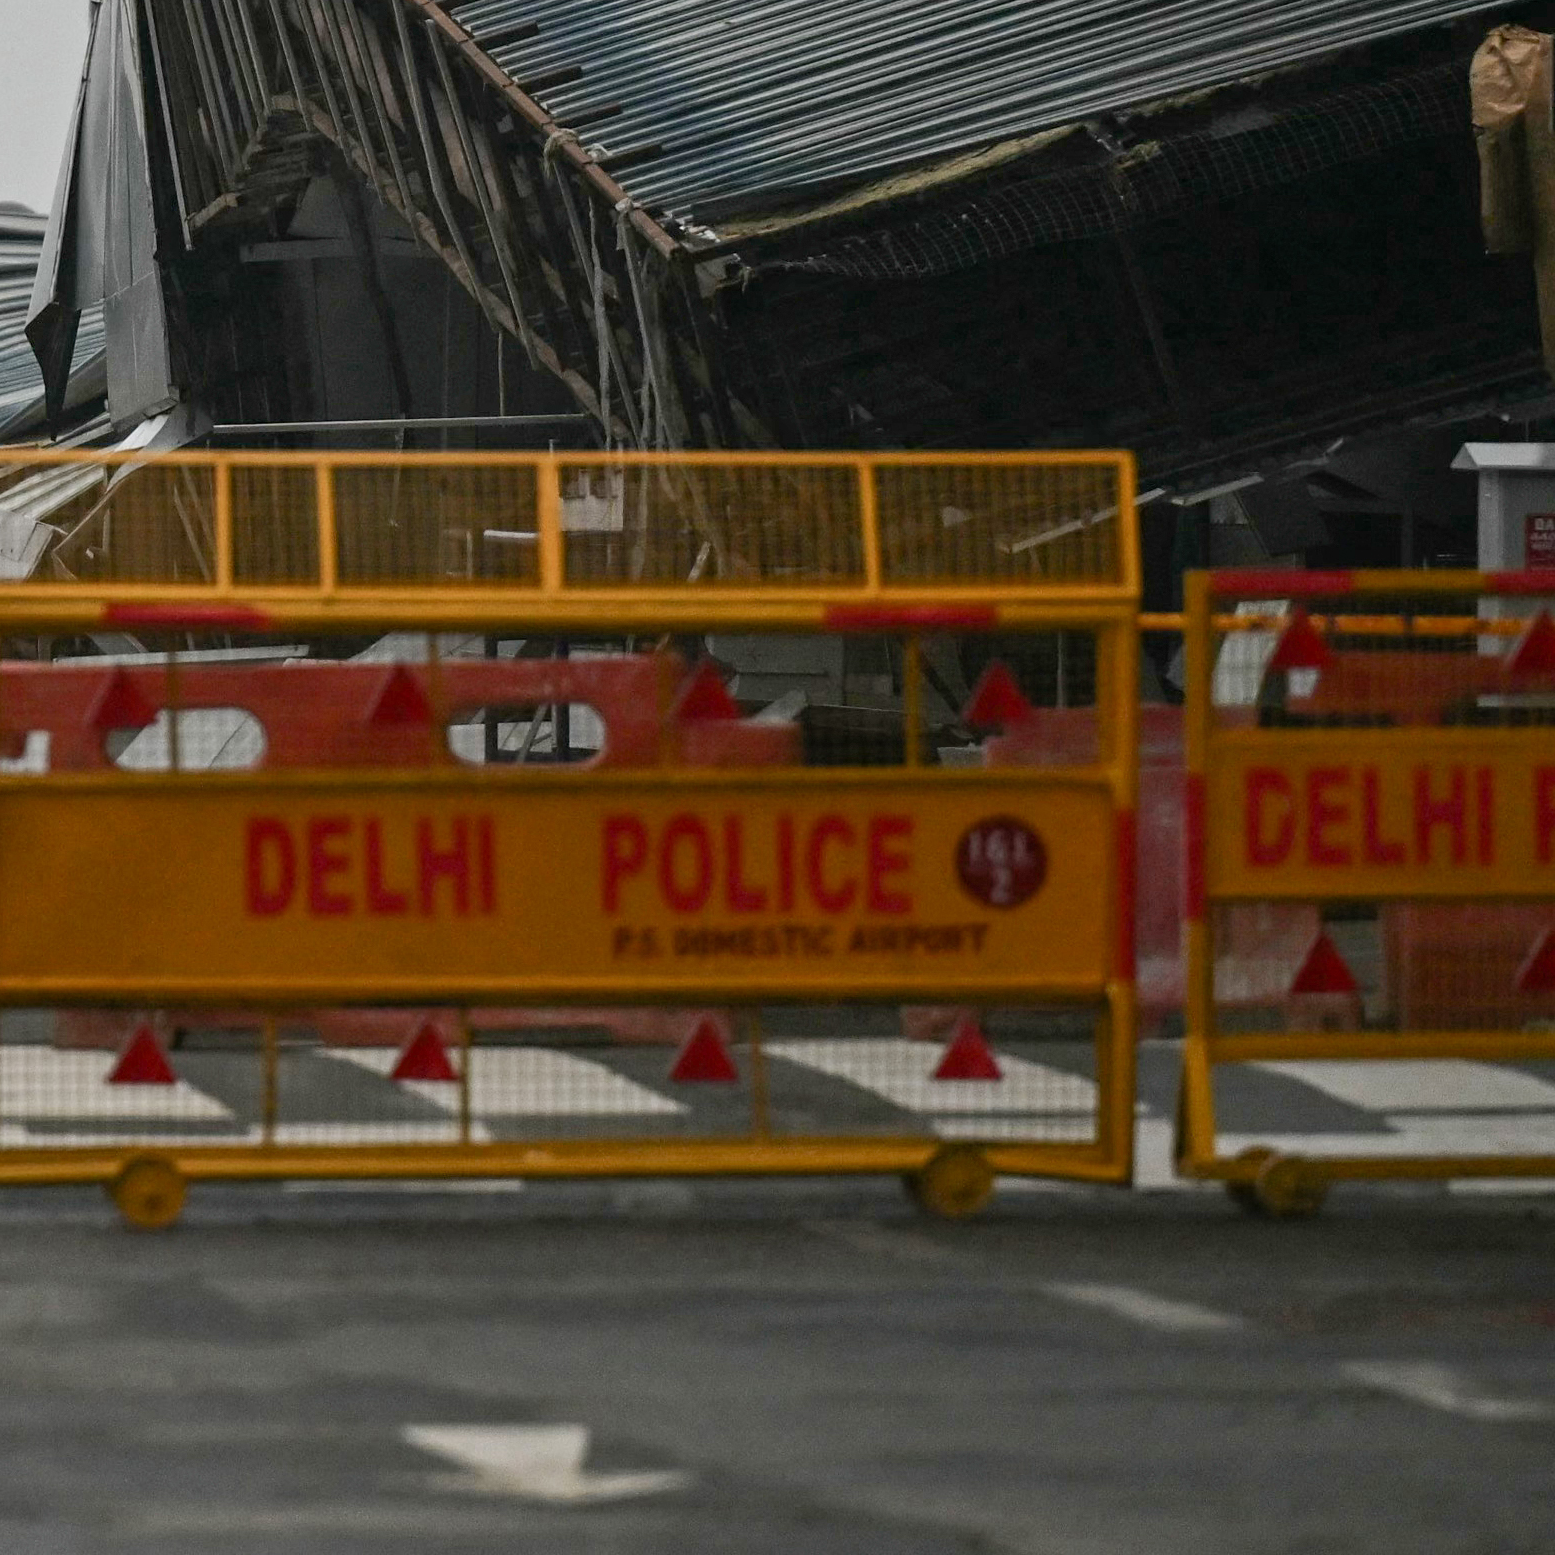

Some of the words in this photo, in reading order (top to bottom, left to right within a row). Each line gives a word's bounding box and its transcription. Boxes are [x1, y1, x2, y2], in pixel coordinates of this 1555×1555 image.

[245, 816, 499, 917] DELHI
[600, 813, 912, 915] POLICE
[1246, 766, 1495, 867] DELHI
[673, 924, 832, 957] DOMESTIC
[848, 922, 989, 955] AIRPORT
